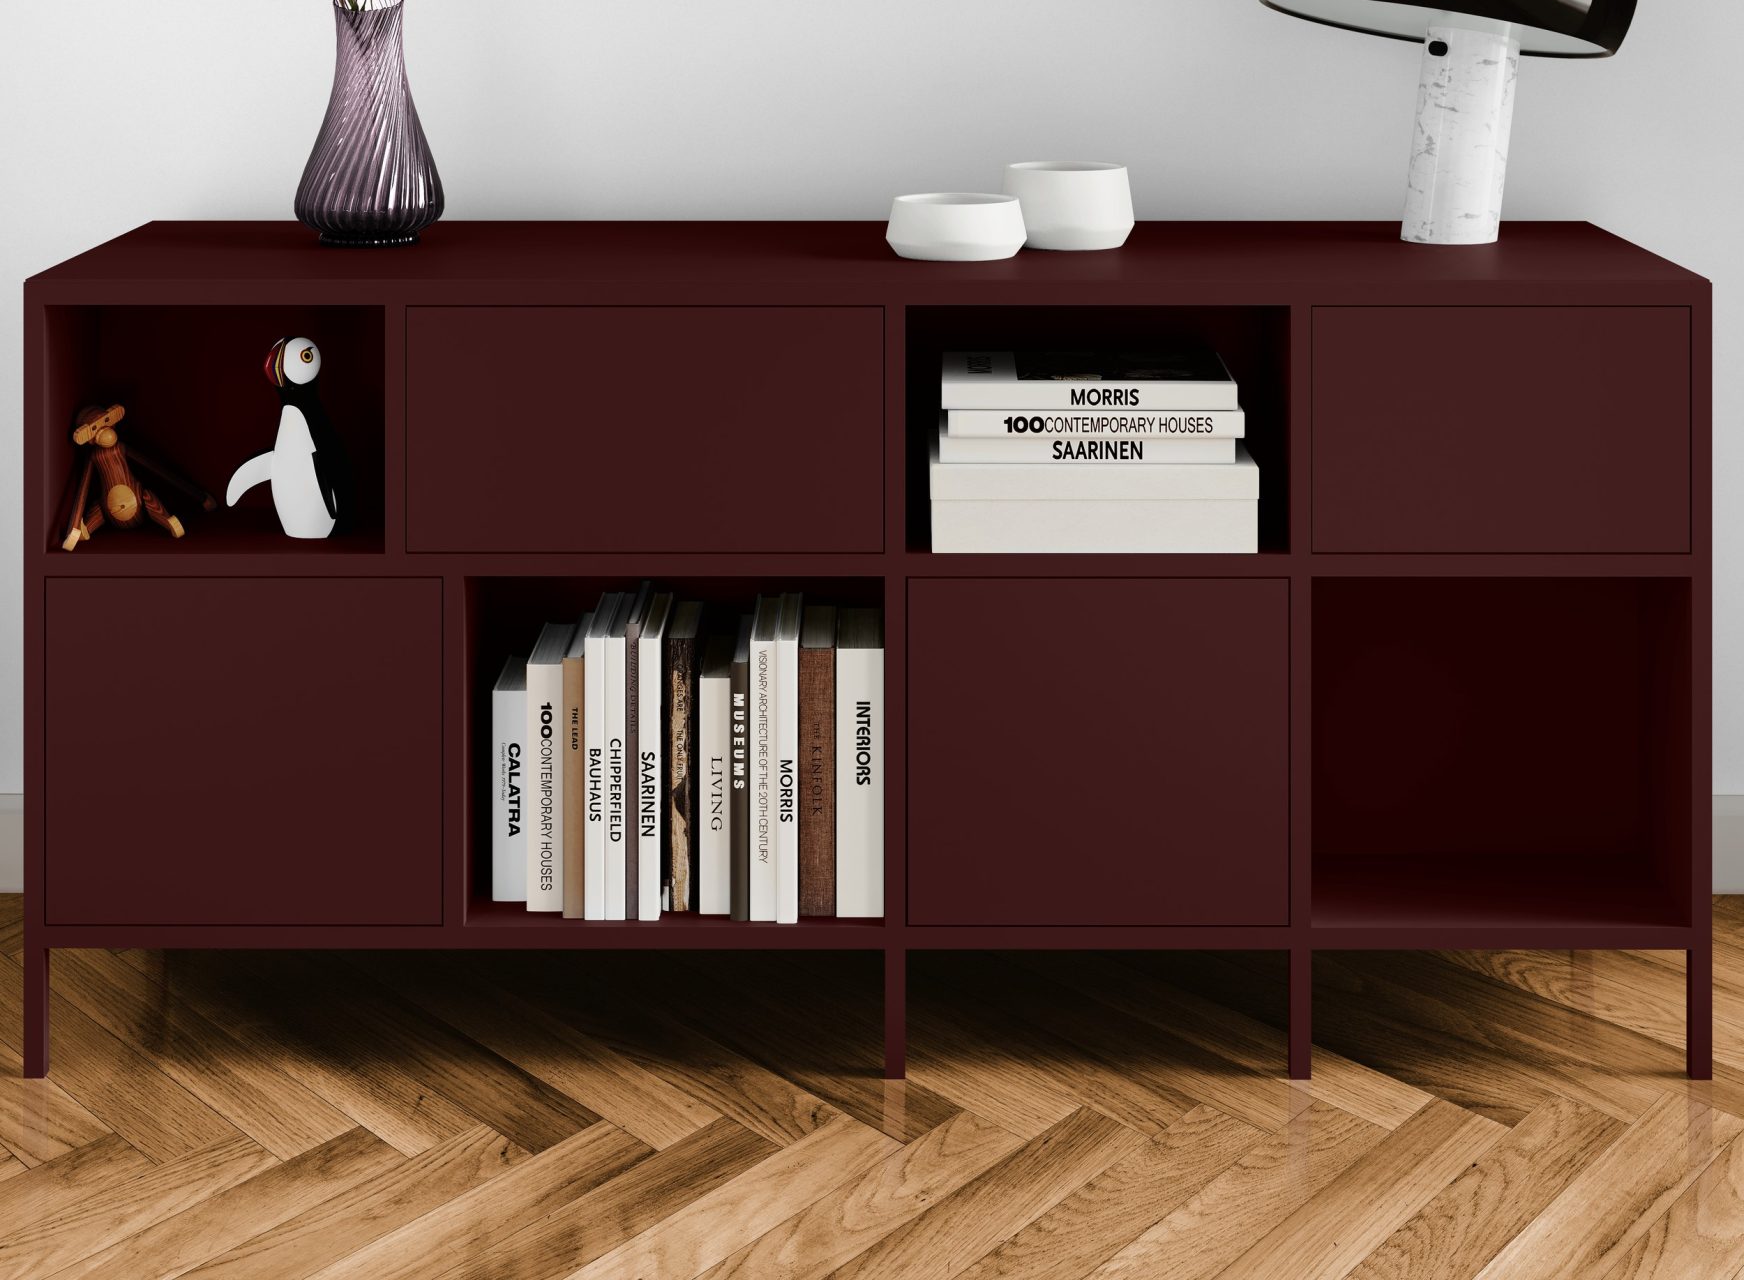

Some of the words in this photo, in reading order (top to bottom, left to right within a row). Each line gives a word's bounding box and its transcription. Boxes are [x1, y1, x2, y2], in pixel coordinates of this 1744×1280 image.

[1070, 388, 1140, 406] MORRIS
[1158, 416, 1214, 434] HOUSES
[1052, 440, 1143, 460] SAARINEN
[758, 649, 768, 690] VISIONARY
[676, 698, 684, 712] ARE
[758, 692, 768, 756] ARCHITECTURE
[676, 729, 684, 742] THE
[676, 743, 684, 761] ONLY
[733, 693, 745, 789] MUSEUMS
[855, 701, 871, 786] INTERIORS
[589, 748, 602, 822] BAUHAUS
[758, 758, 768, 769] OF
[758, 769, 768, 790] THE
[811, 746, 822, 816] KINFOLK
[508, 742, 521, 838] CALATRA
[609, 738, 622, 842] CHIPPERFIELD
[641, 751, 656, 837] SAARINEN
[711, 756, 723, 832] LIVING
[758, 792, 768, 817] 20TH
[780, 759, 794, 823] MORRIS
[758, 818, 768, 864] CENTURY
[540, 841, 553, 891] HOUSES
